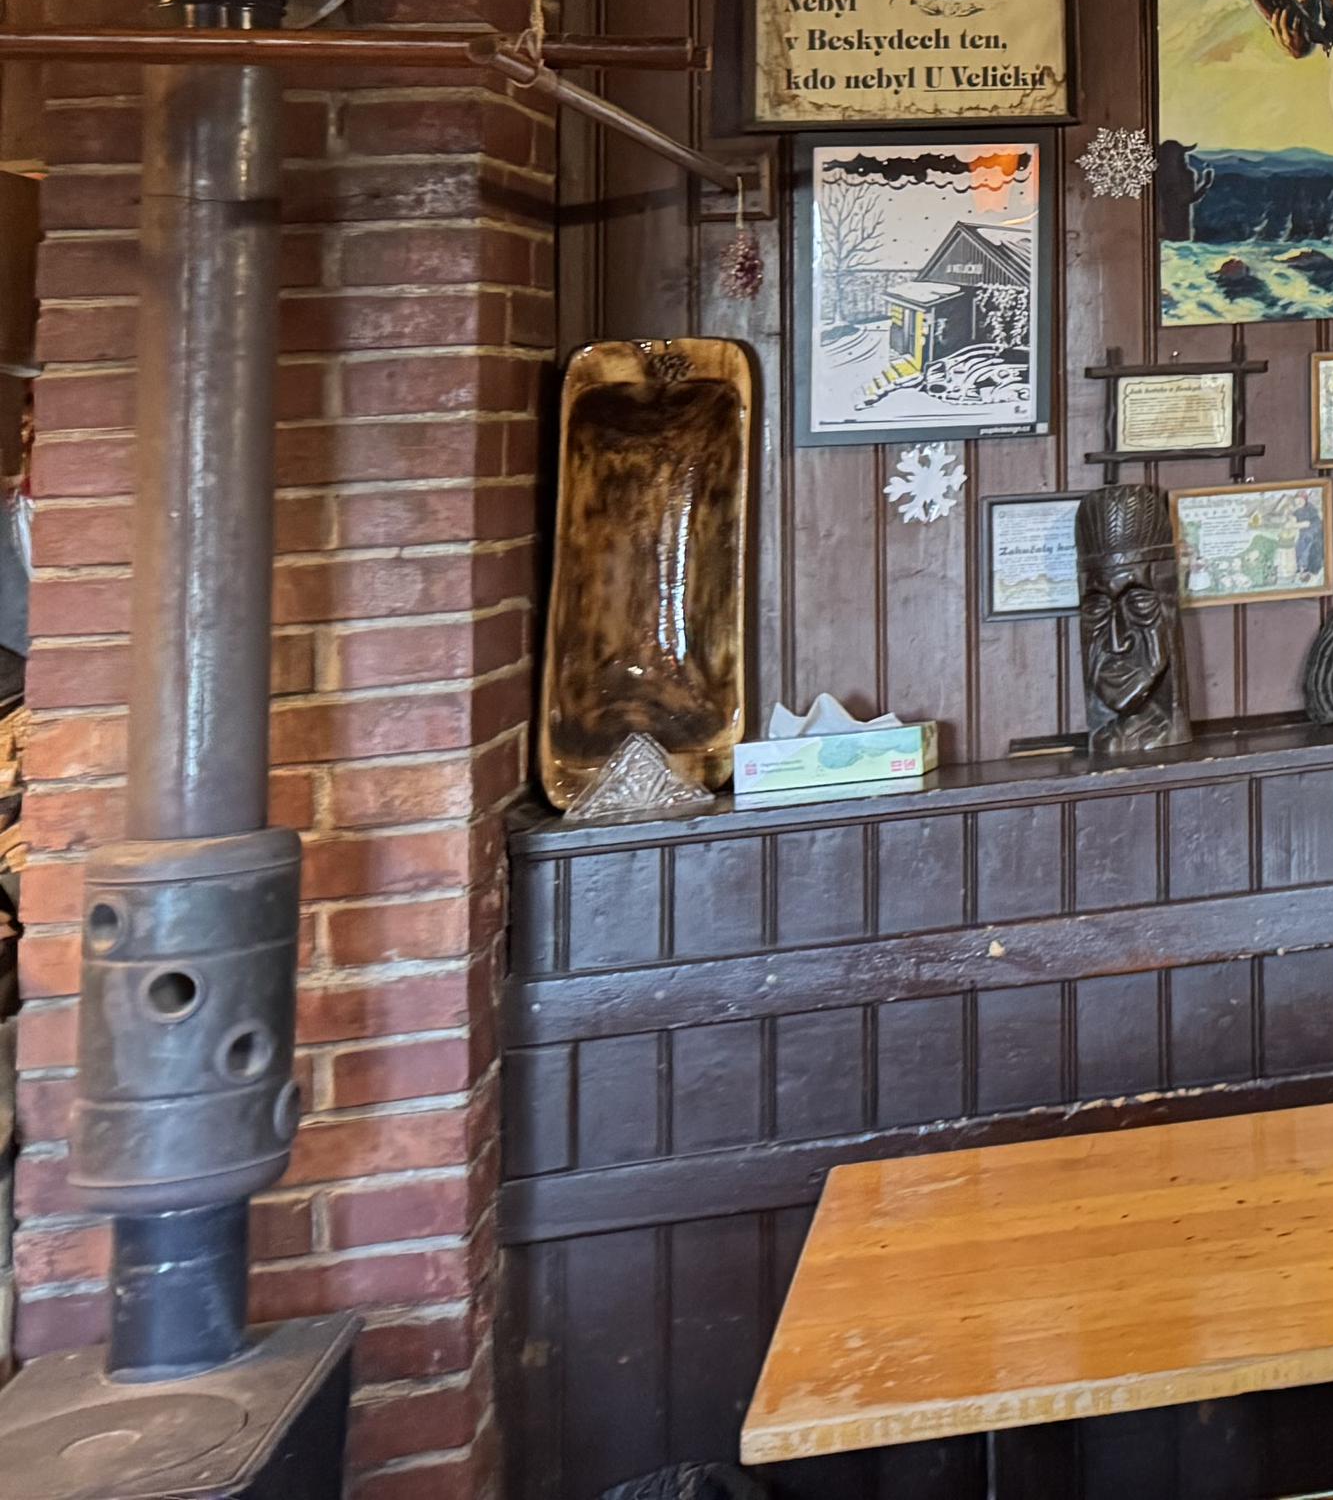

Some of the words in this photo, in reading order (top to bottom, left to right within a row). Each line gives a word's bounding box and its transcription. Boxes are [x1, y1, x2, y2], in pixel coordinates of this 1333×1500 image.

[785, 33, 800, 52] v
[807, 28, 951, 57] Beskydech
[959, 29, 1008, 53] ten,
[786, 67, 836, 91] kdo
[845, 66, 916, 95] nebyl
[923, 66, 945, 89] U
[951, 63, 1047, 89] Veličků
